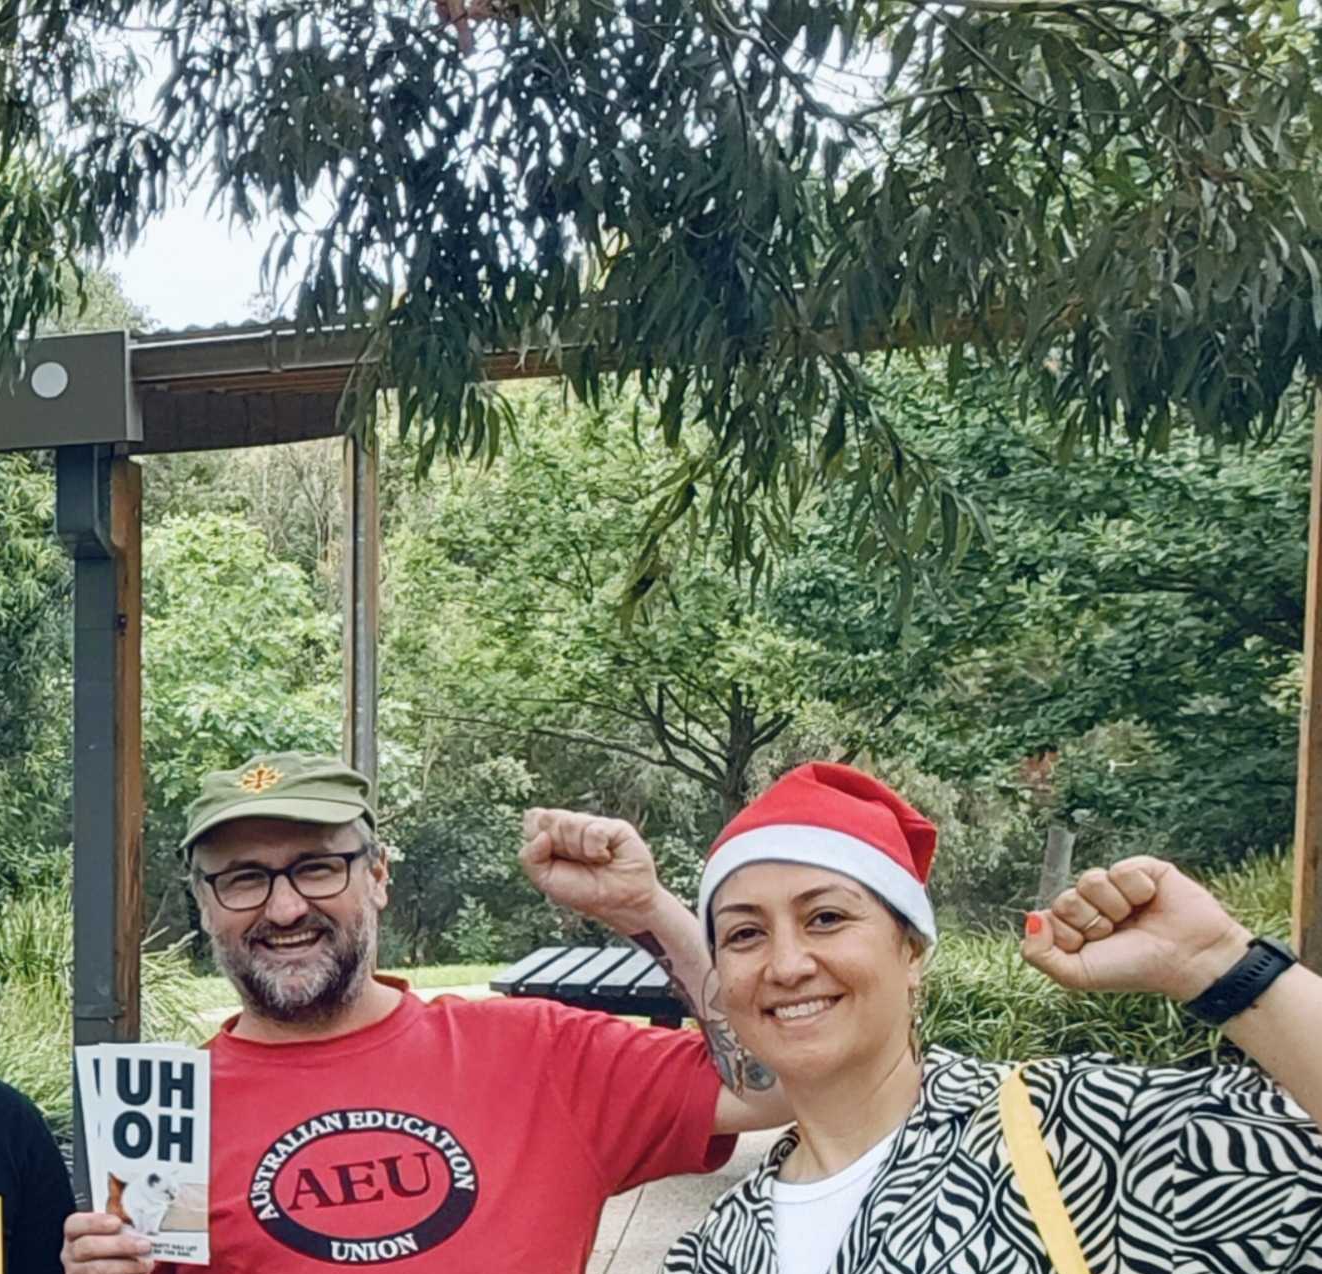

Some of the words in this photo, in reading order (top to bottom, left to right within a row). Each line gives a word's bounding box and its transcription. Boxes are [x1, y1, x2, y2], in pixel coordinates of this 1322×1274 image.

[116, 1056, 195, 1110] UH
[112, 1111, 195, 1164] OH
[253, 1112, 345, 1221] AUSTRALIAN
[348, 1110, 475, 1191] EDUCATION
[287, 1151, 433, 1211] AEU
[330, 1232, 419, 1262] UNION
